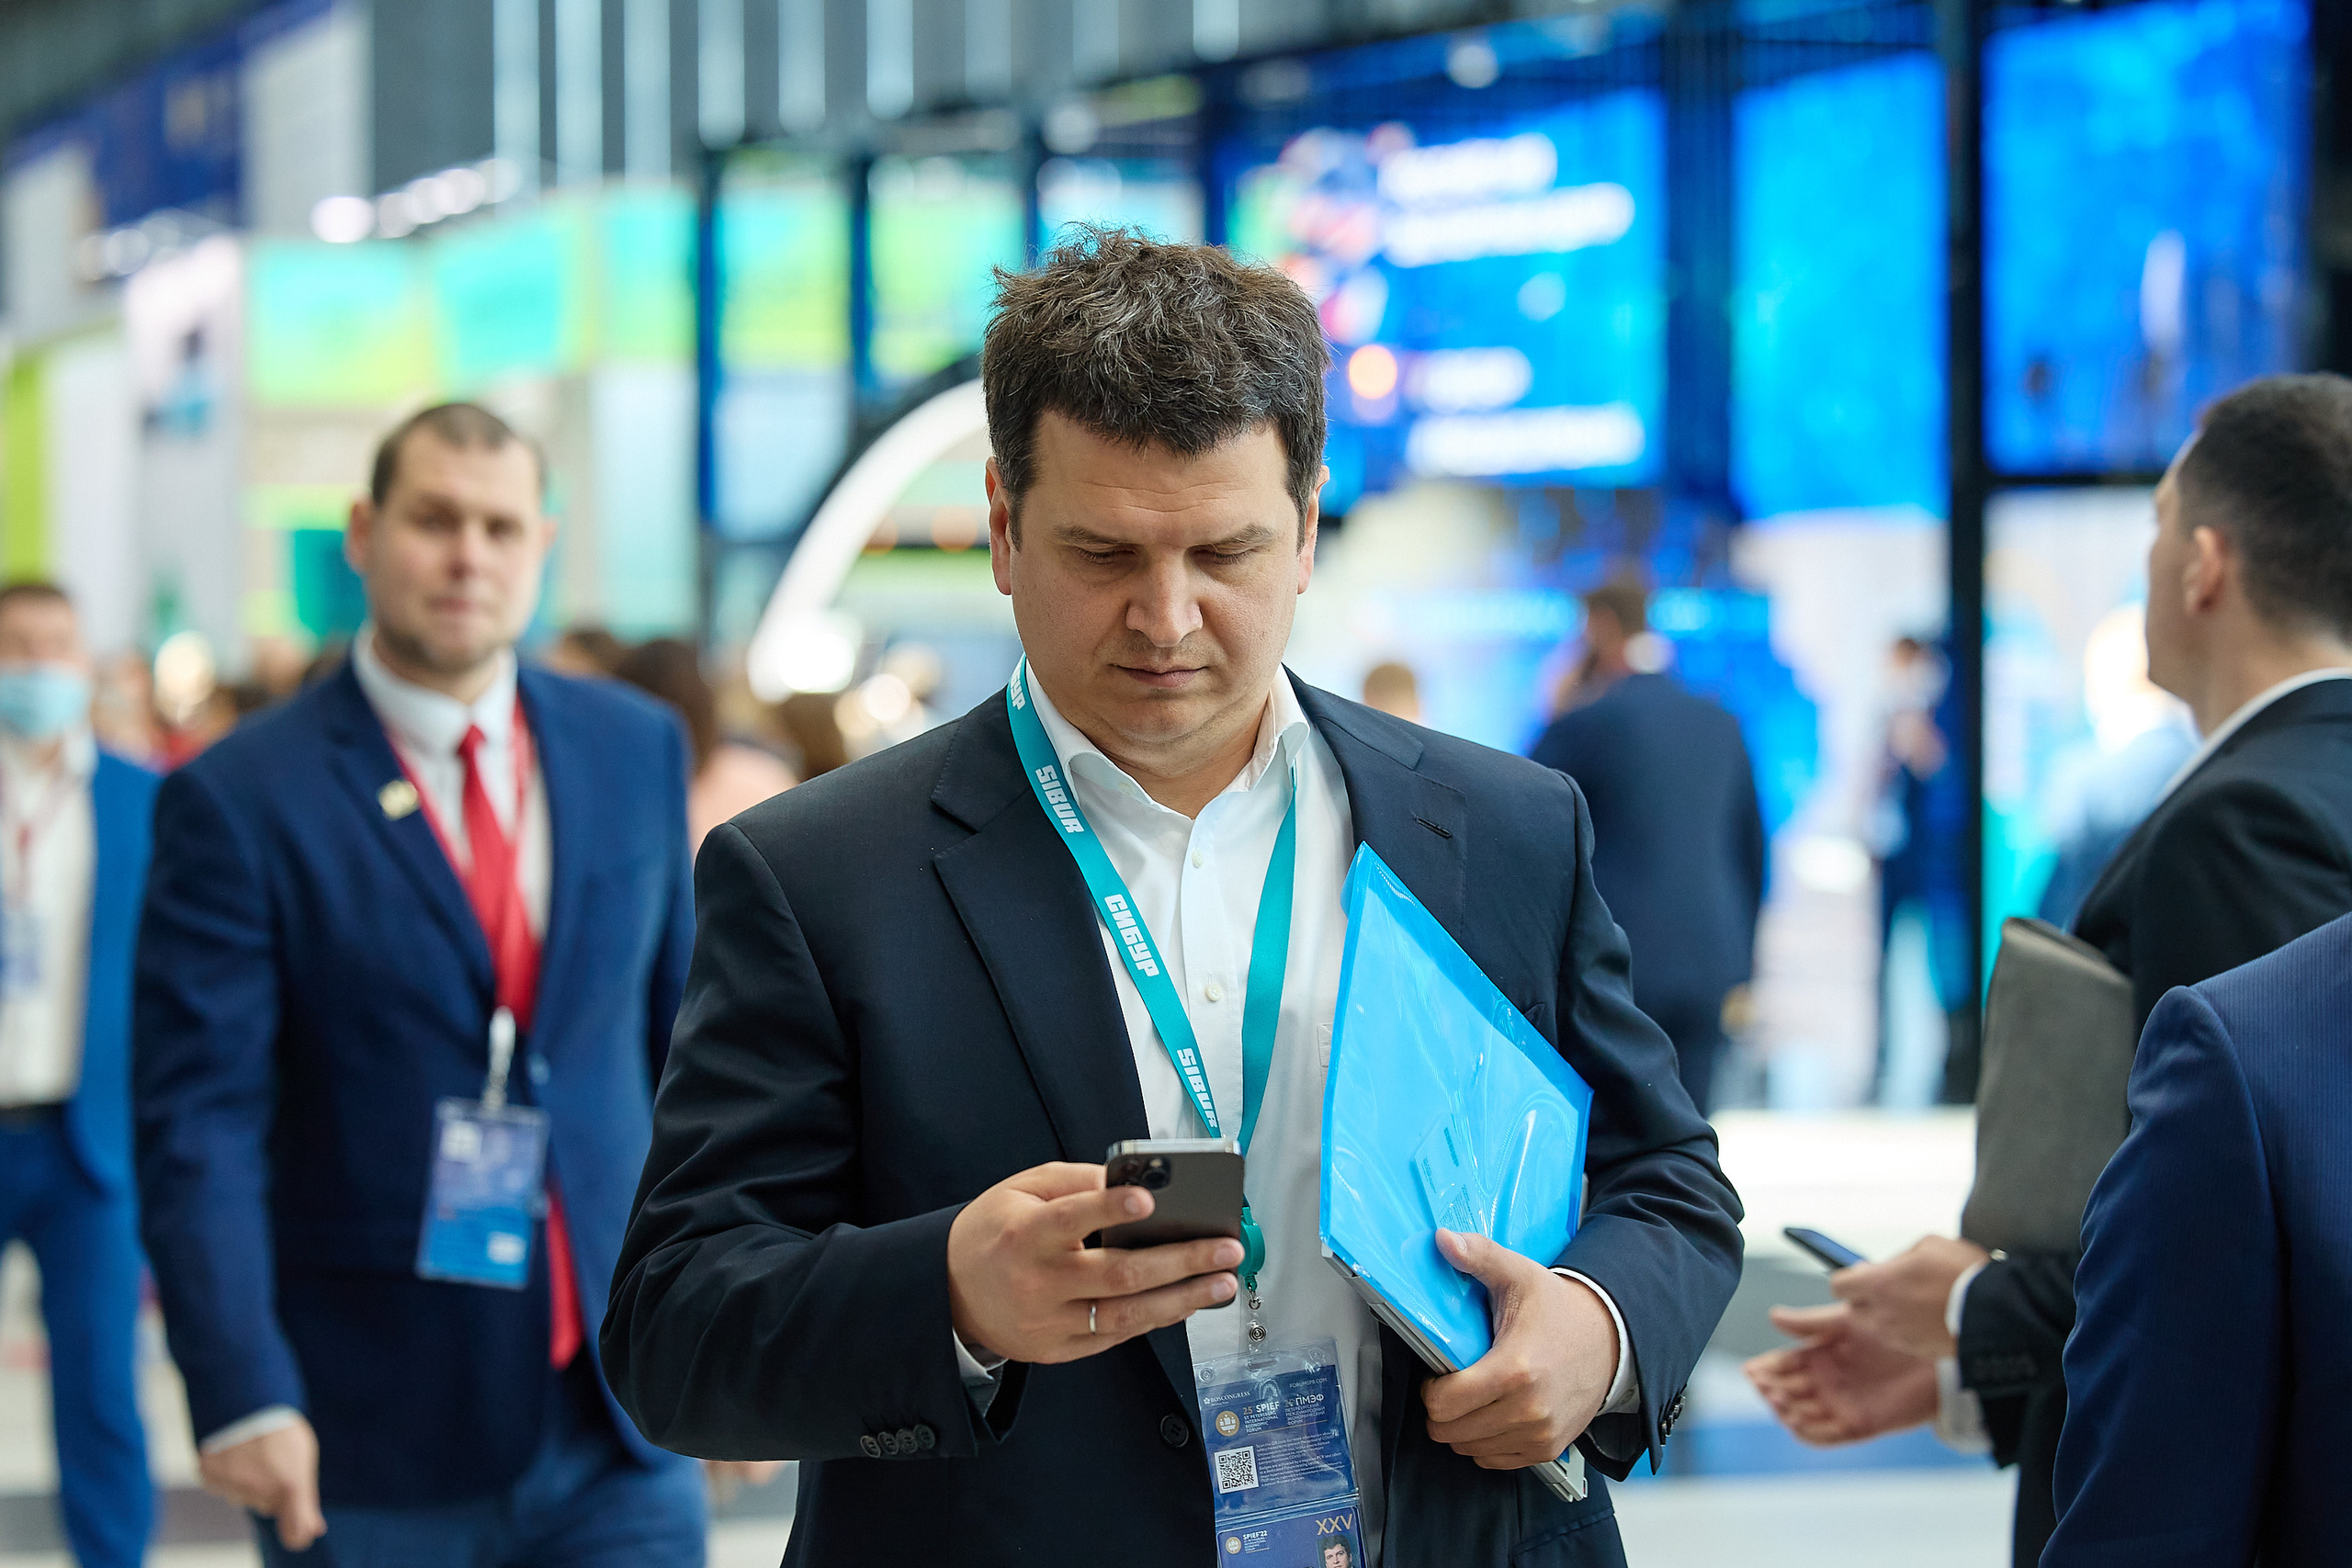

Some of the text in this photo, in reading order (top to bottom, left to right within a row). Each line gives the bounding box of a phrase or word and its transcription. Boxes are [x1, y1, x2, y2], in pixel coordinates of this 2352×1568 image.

[1011, 653, 1026, 710] БУР
[1035, 764, 1085, 834] SIBUR
[1103, 894, 1160, 977] СИБУР
[1176, 1047, 1217, 1129] SIBUR
[1256, 1401, 1280, 1413] SPIEF
[1295, 1393, 1325, 1405] ПМЭФ
[1245, 1415, 1279, 1425] INTERNATIONAL
[1316, 1514, 1353, 1535] XXV
